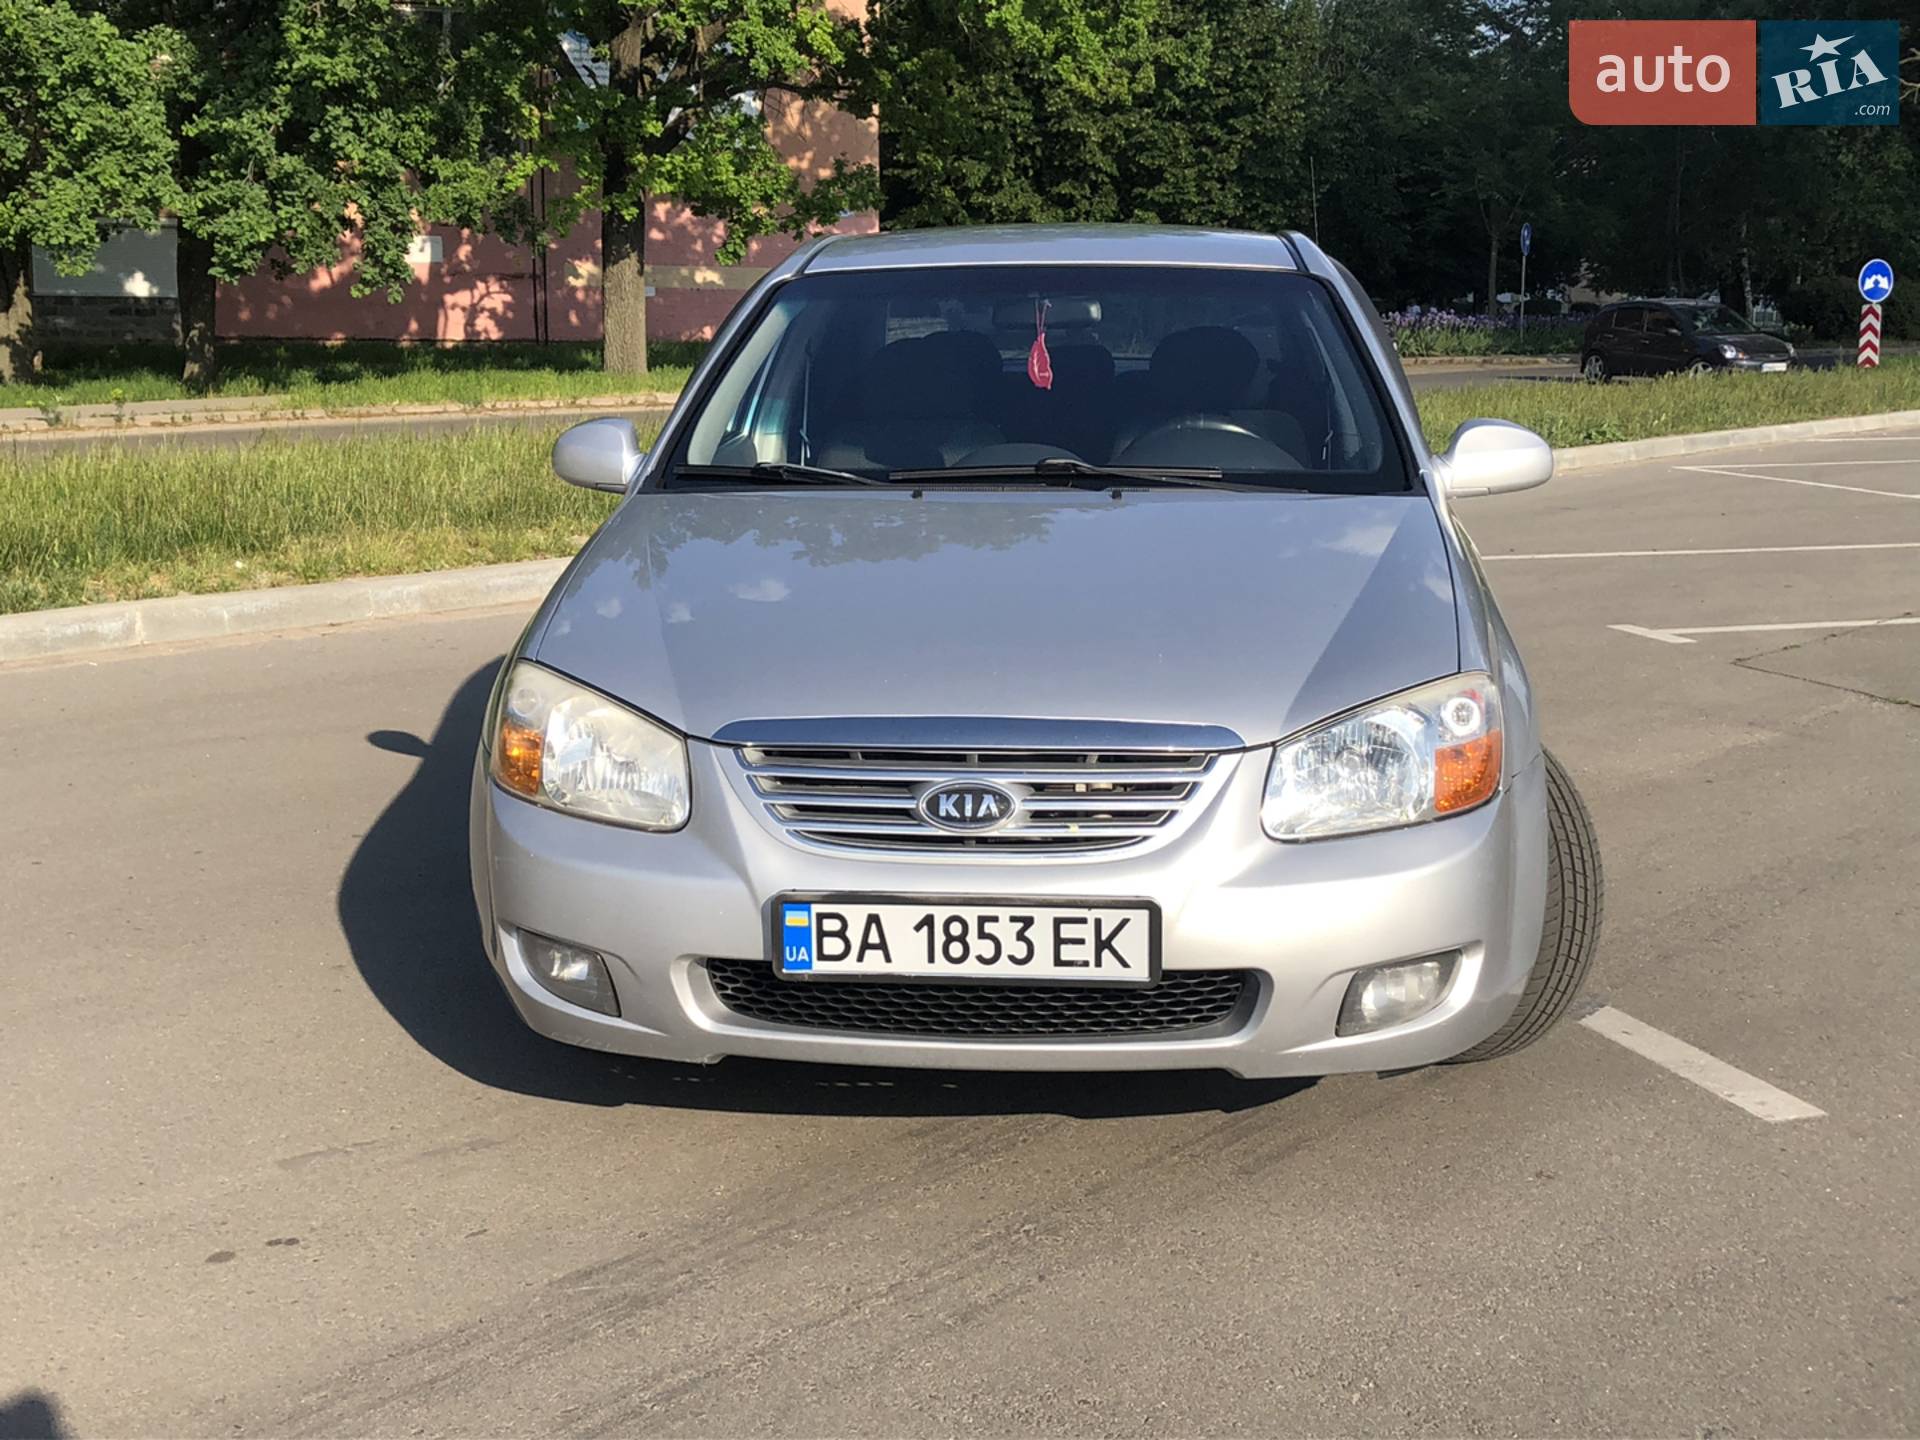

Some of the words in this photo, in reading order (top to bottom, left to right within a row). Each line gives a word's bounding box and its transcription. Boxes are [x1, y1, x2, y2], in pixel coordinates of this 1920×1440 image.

[938, 793, 1000, 818] KIA
[815, 911, 893, 964] BA
[912, 913, 1035, 966] 1853
[1053, 917, 1132, 969] EK
[785, 945, 810, 963] UA
